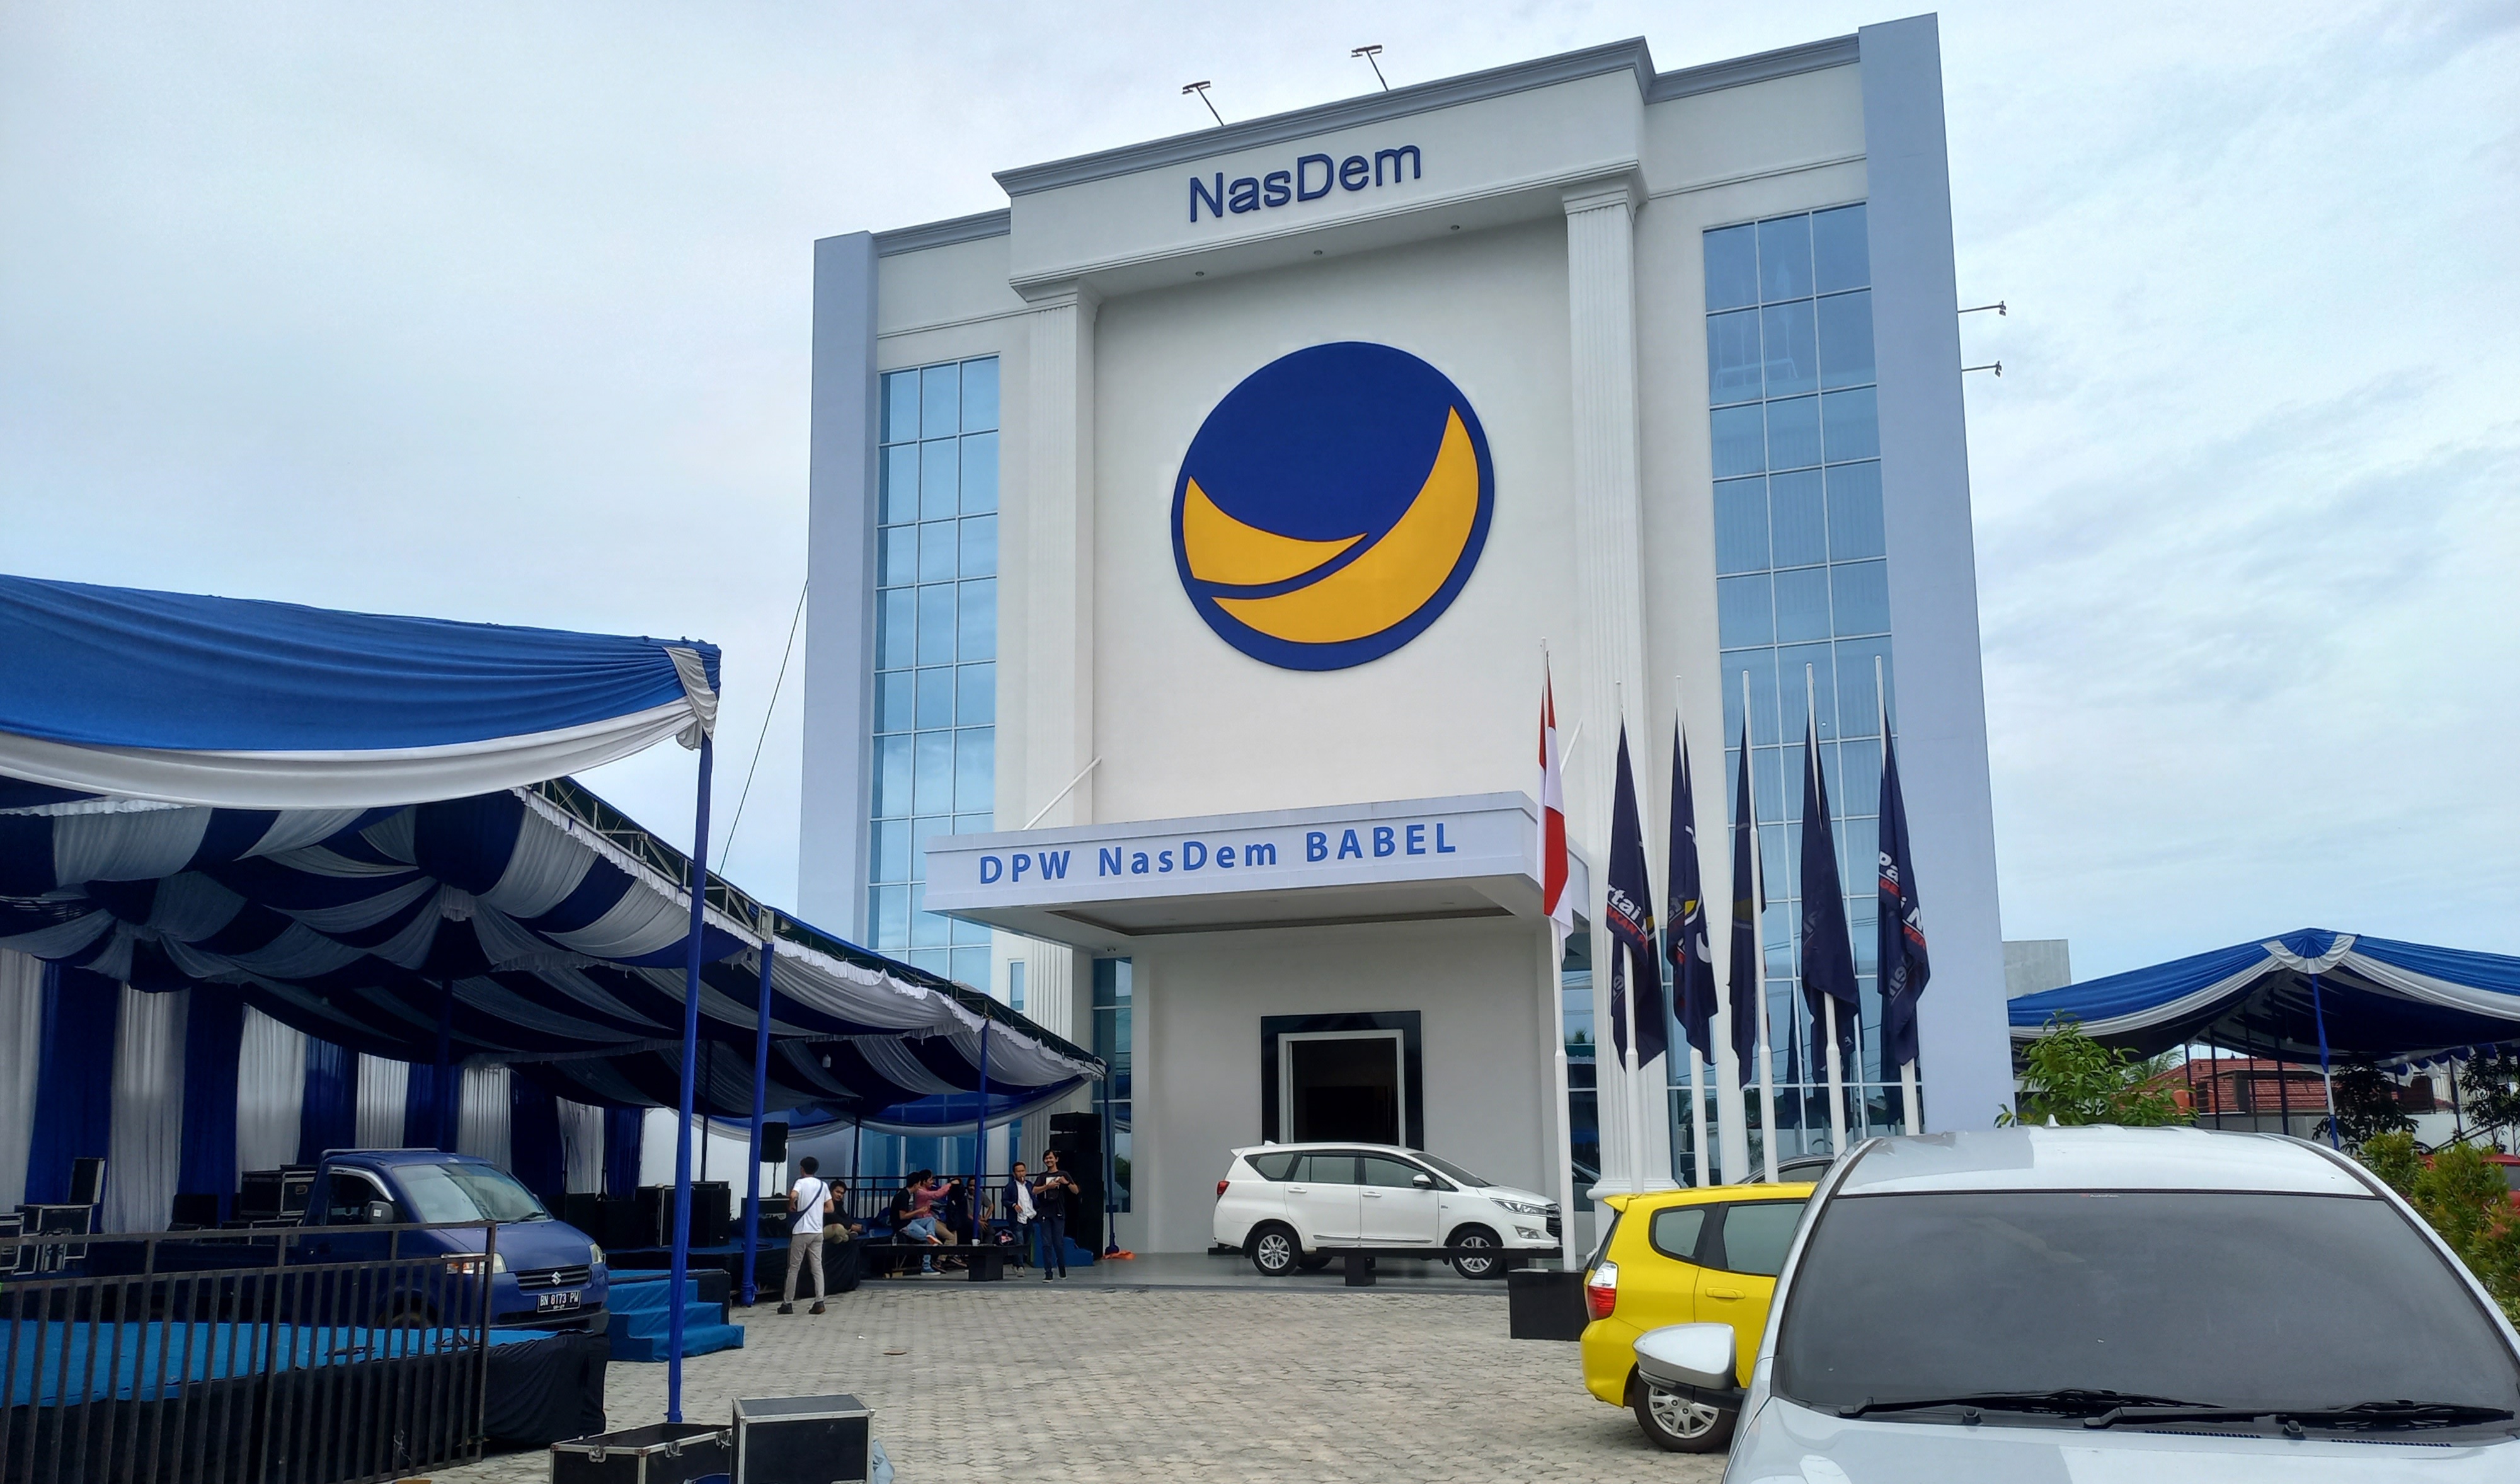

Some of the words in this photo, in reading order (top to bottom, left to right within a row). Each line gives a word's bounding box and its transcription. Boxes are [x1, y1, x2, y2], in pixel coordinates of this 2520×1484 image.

[1190, 144, 1421, 222] NasDem
[979, 849, 1072, 885] DPW
[1097, 840, 1278, 878] NasDem
[1306, 822, 1457, 863] BABEL
[540, 1294, 549, 1306] BN
[551, 1292, 567, 1305] 8173
[570, 1291, 579, 1303] PW
